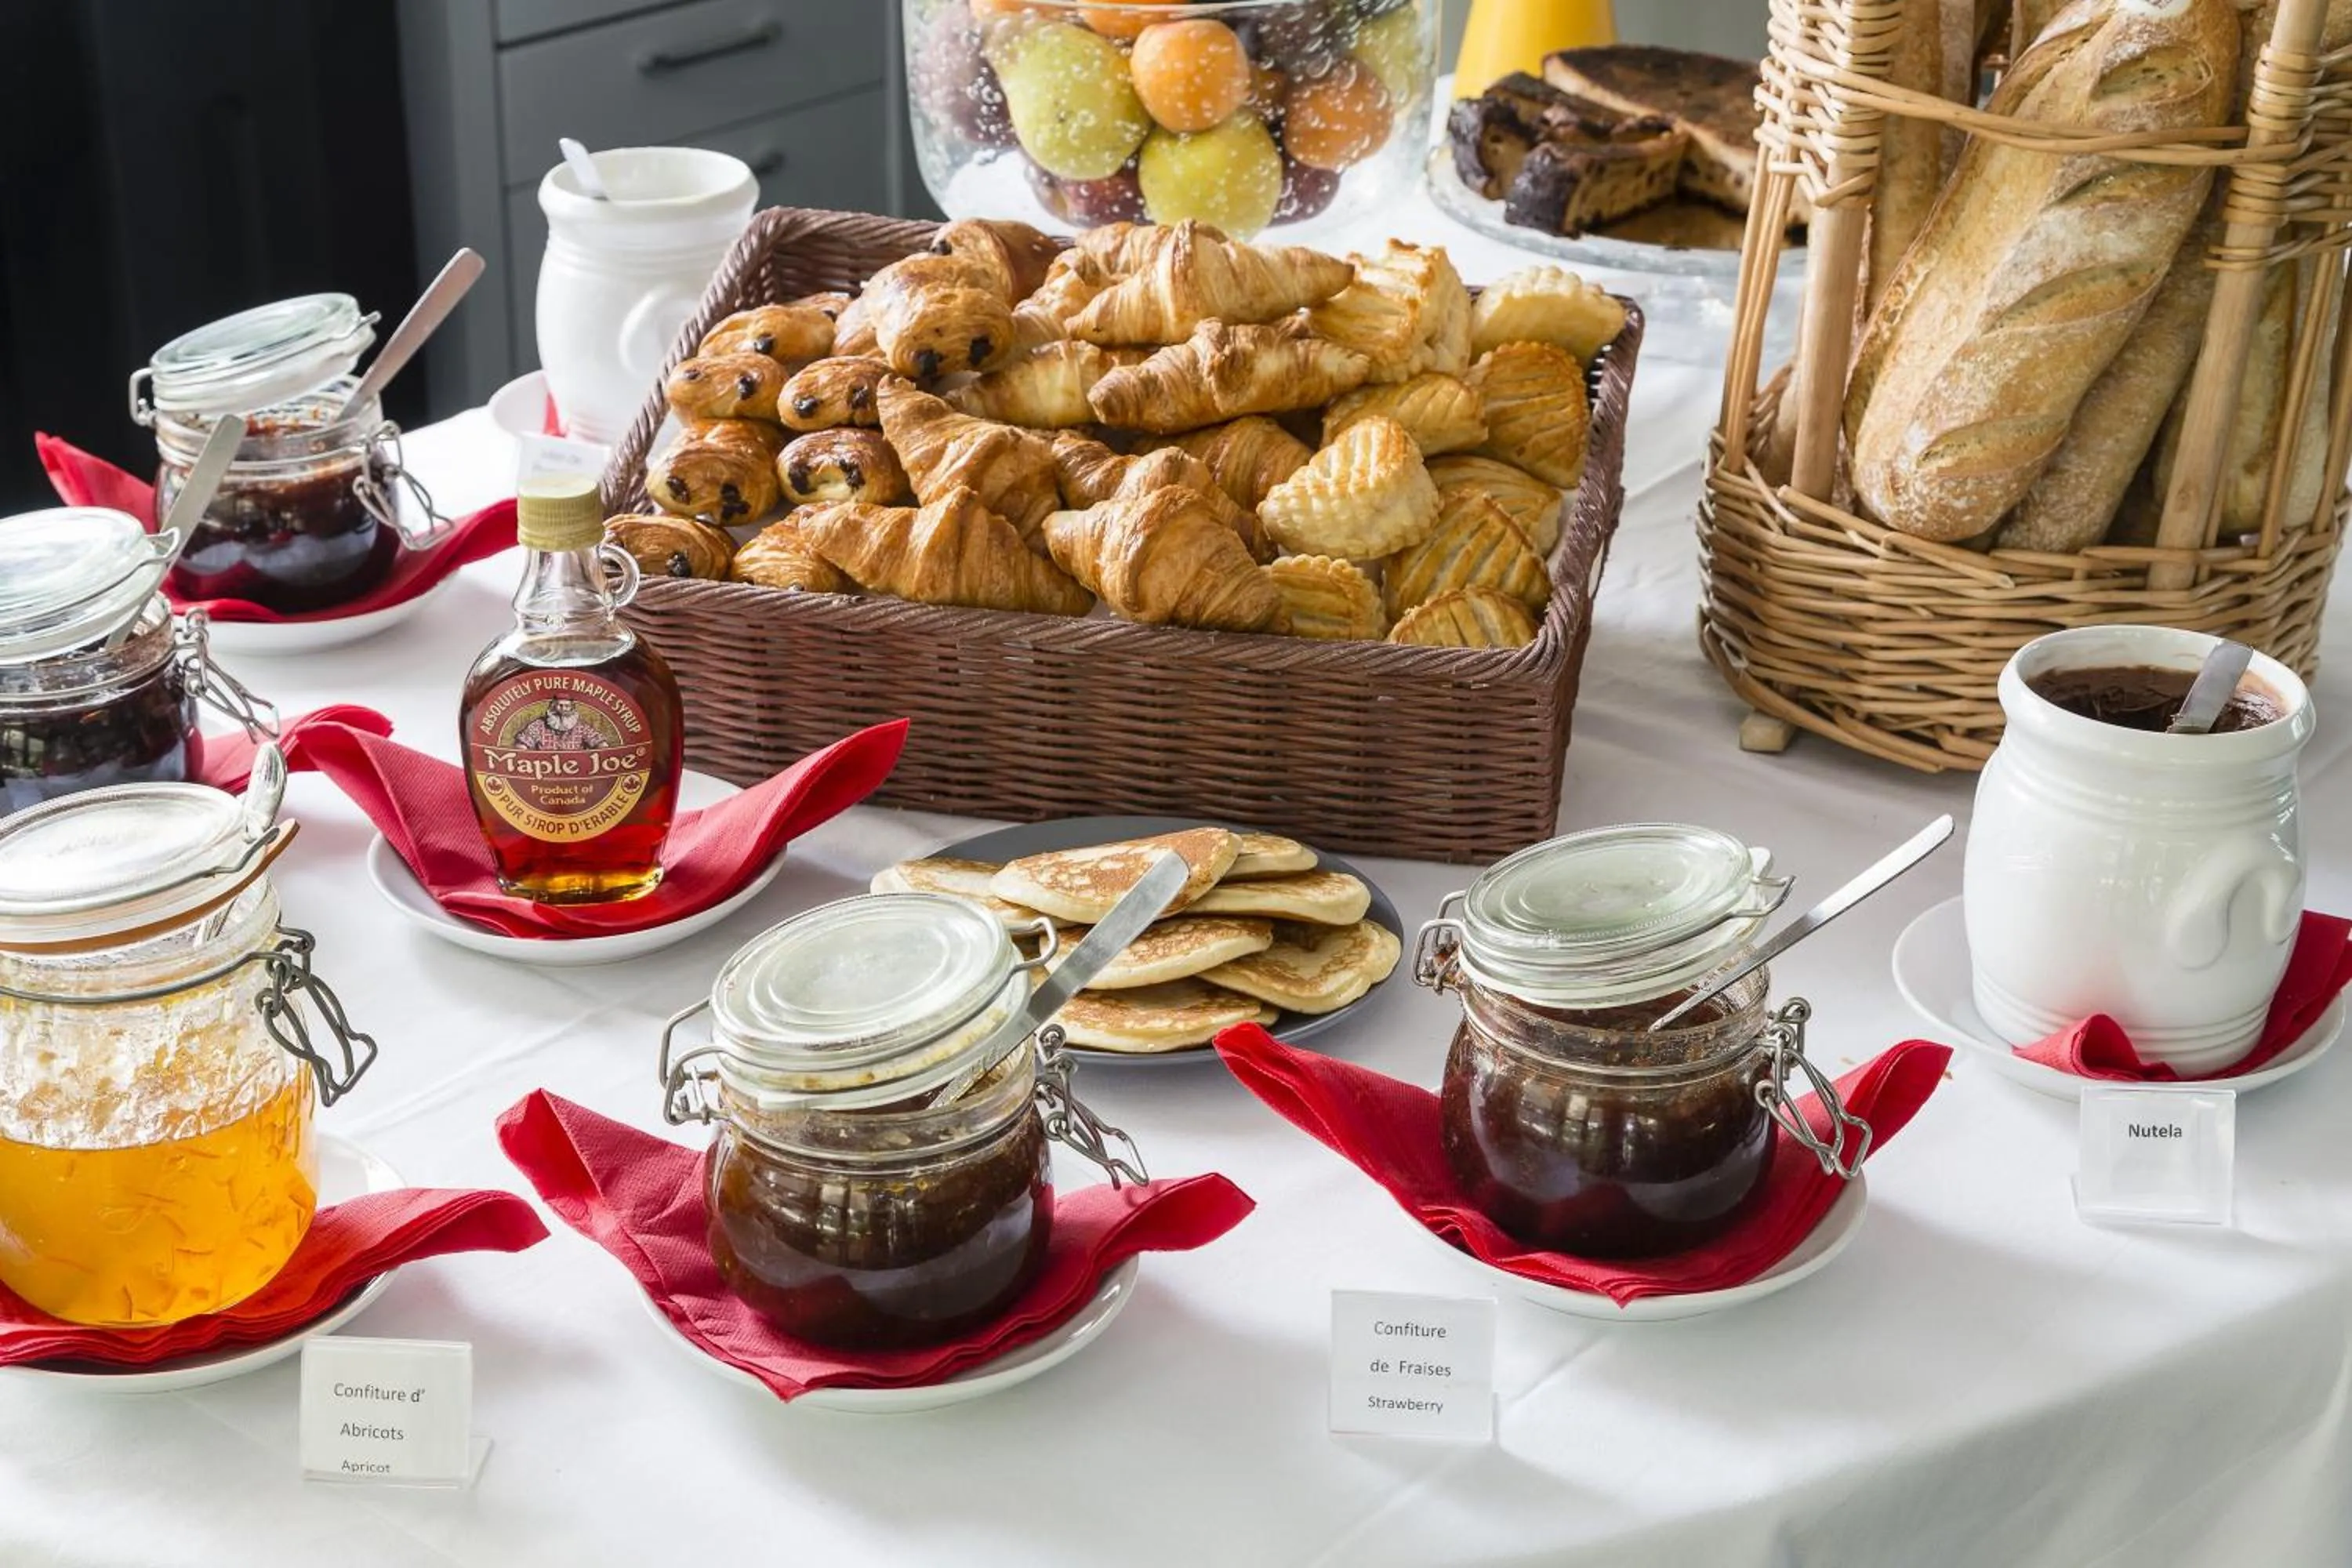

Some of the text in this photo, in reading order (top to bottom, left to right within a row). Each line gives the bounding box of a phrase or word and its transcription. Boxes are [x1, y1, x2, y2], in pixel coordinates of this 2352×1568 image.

[480, 677, 641, 735] ABSOLUTELY PURE MAPLE SYRUP
[484, 749, 579, 780] Maple
[531, 785, 593, 794] Product of
[539, 795, 586, 805] Canada
[499, 793, 628, 835] PUR SIROP D'ERABLE
[2129, 1123, 2183, 1138] Nutela
[1374, 1320, 1446, 1338] Confiture
[1370, 1359, 1452, 1377] de Fraises
[333, 1382, 407, 1402] Confiture
[1367, 1395, 1443, 1414] Strawberry
[339, 1423, 405, 1441] Abricots
[341, 1460, 390, 1474] Apricot
